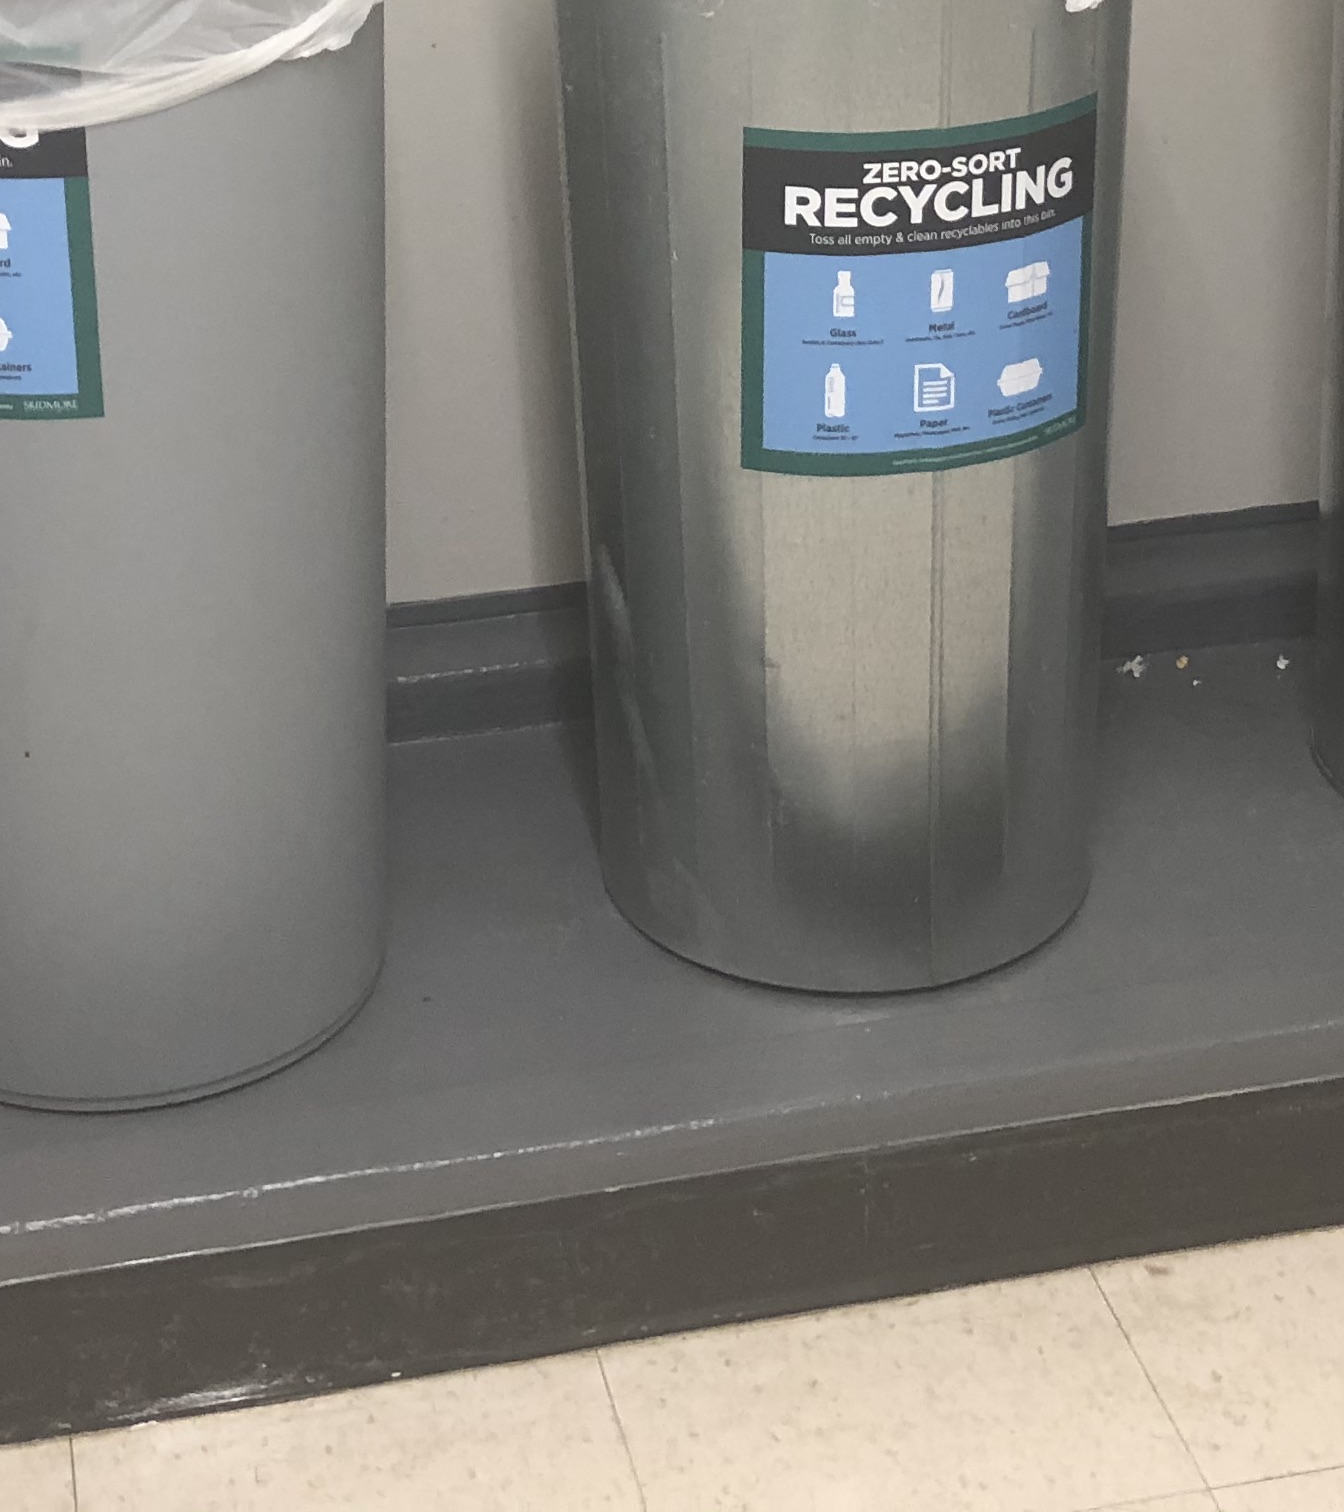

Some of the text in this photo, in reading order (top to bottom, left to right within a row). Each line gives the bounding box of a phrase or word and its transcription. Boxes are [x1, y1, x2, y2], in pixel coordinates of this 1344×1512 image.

[863, 148, 1022, 185] ZERO-SORT
[784, 157, 1073, 228] RECYCLING
[810, 233, 834, 244] Toss
[838, 235, 852, 244] all
[854, 235, 892, 246] empty
[896, 232, 904, 242] &
[907, 231, 938, 242] clean
[941, 223, 999, 240] recyclables
[1001, 218, 1021, 230] into
[816, 423, 850, 433] Plastic
